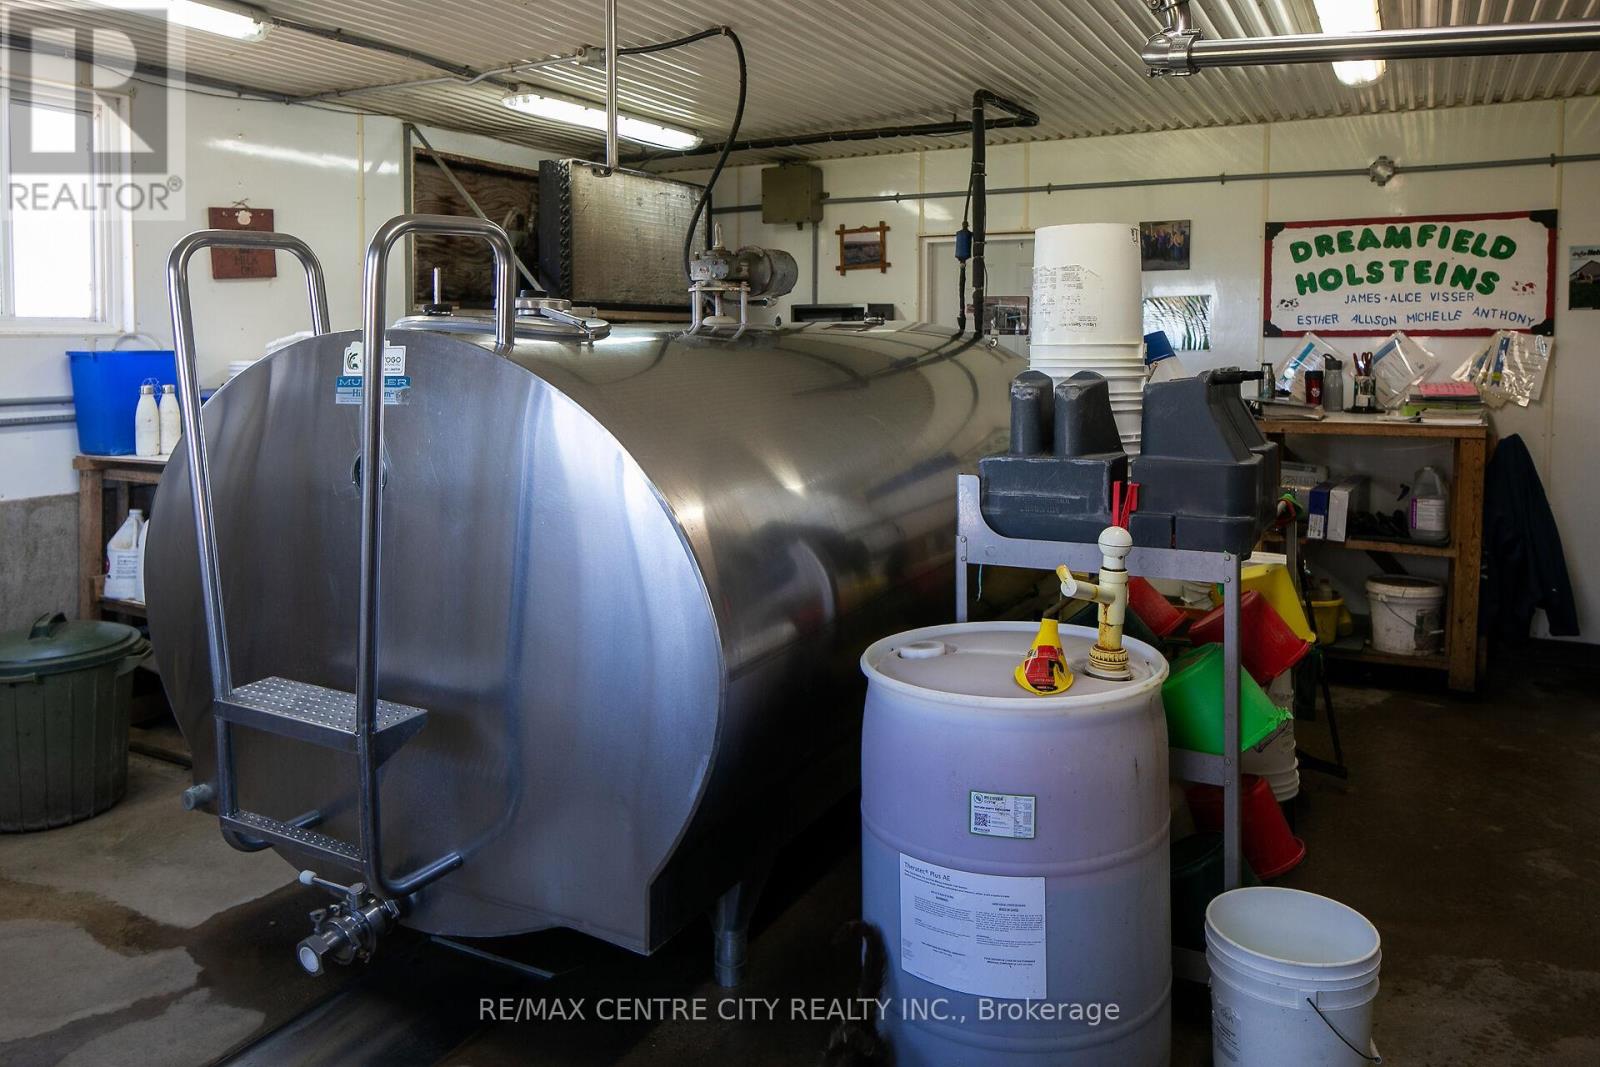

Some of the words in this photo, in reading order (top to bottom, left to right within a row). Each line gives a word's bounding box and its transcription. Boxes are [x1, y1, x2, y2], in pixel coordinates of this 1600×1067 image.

[1289, 223, 1517, 263] DREAMFIELD
[1294, 259, 1500, 296] HOLSTEINS
[1430, 291, 1475, 302] VISSER
[1297, 313, 1340, 326] ESTHER
[1350, 315, 1398, 327] ALLISON
[1406, 309, 1463, 324] MICHELLE
[1472, 306, 1536, 327] ANTHONY
[929, 870, 942, 880] Plus
[942, 874, 951, 882] AE
